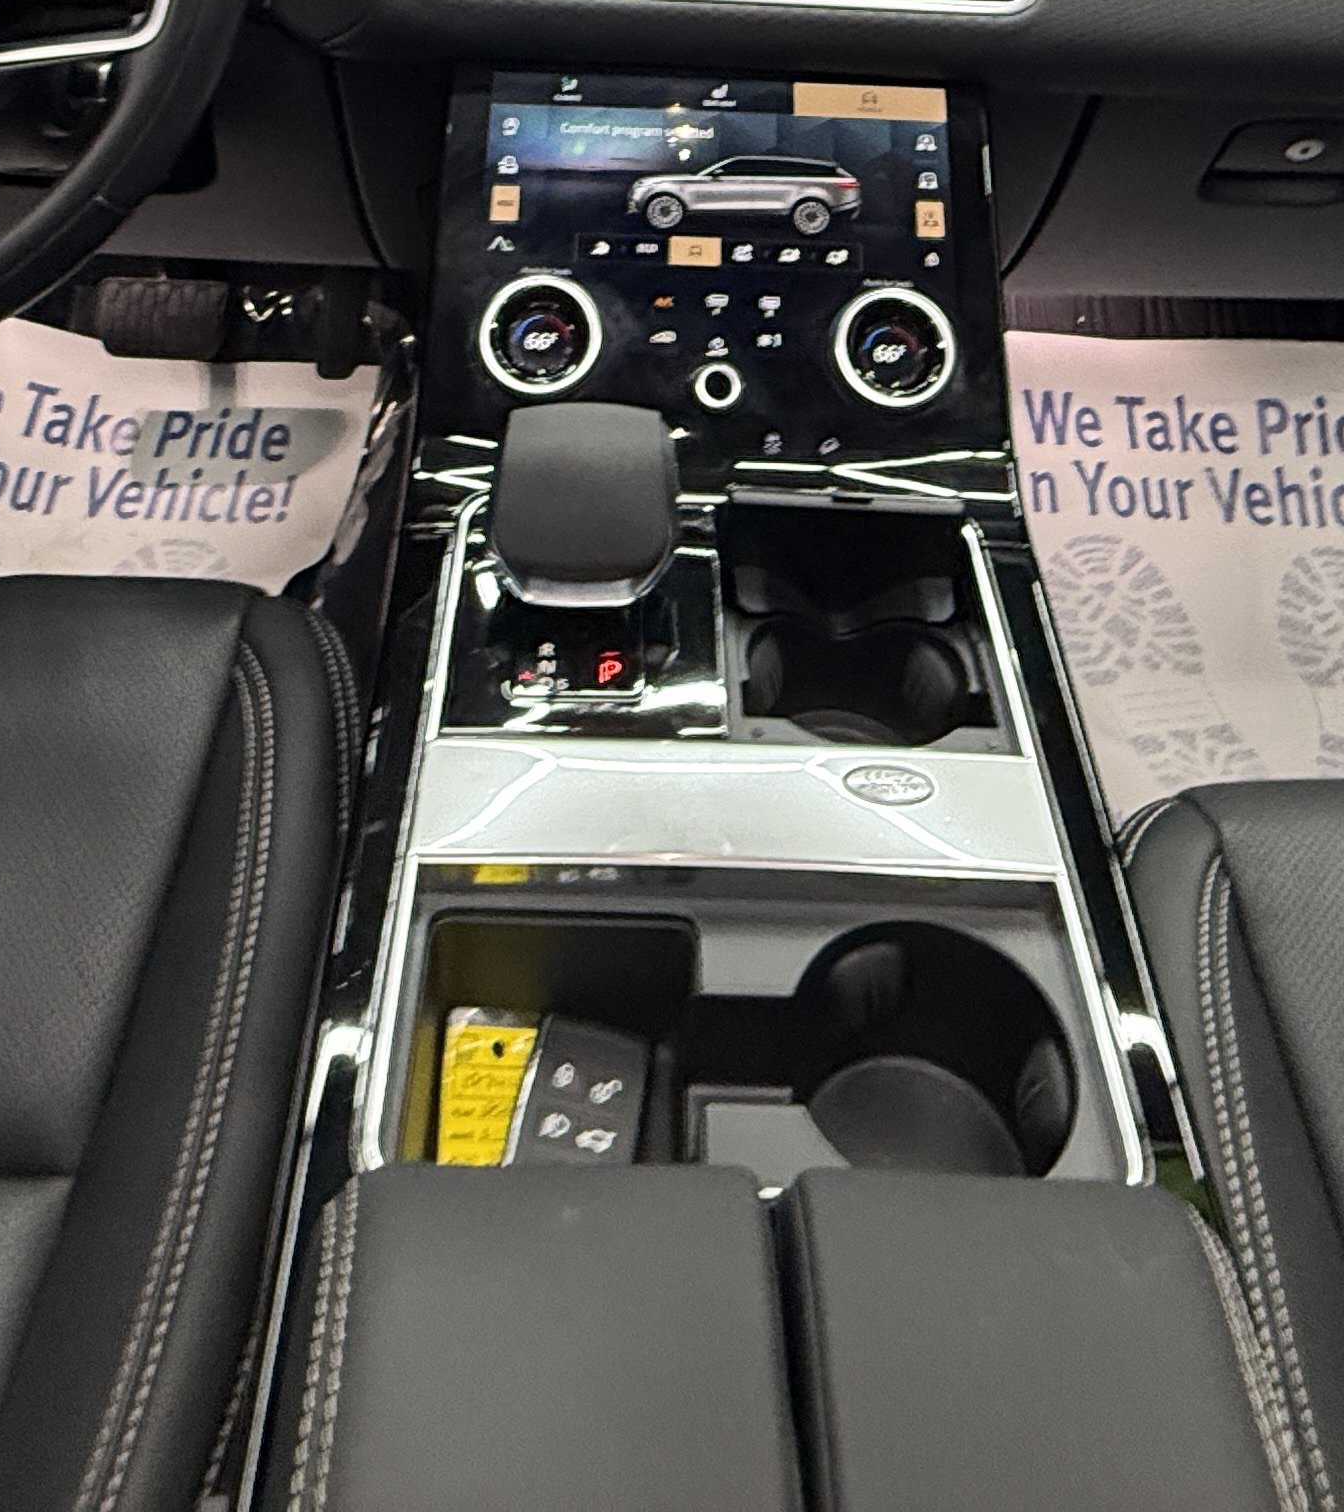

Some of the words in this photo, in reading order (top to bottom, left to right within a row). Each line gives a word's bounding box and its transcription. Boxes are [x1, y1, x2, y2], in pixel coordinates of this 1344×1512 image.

[560, 122, 610, 136] Comfort
[21, 381, 140, 454] Take
[154, 410, 291, 462] Pride
[1022, 389, 1102, 448] We
[1114, 394, 1240, 455] Take
[86, 465, 299, 524] Vehicle!
[1028, 468, 1059, 514] n
[1072, 460, 1194, 521] Your
[598, 660, 623, 684] P
